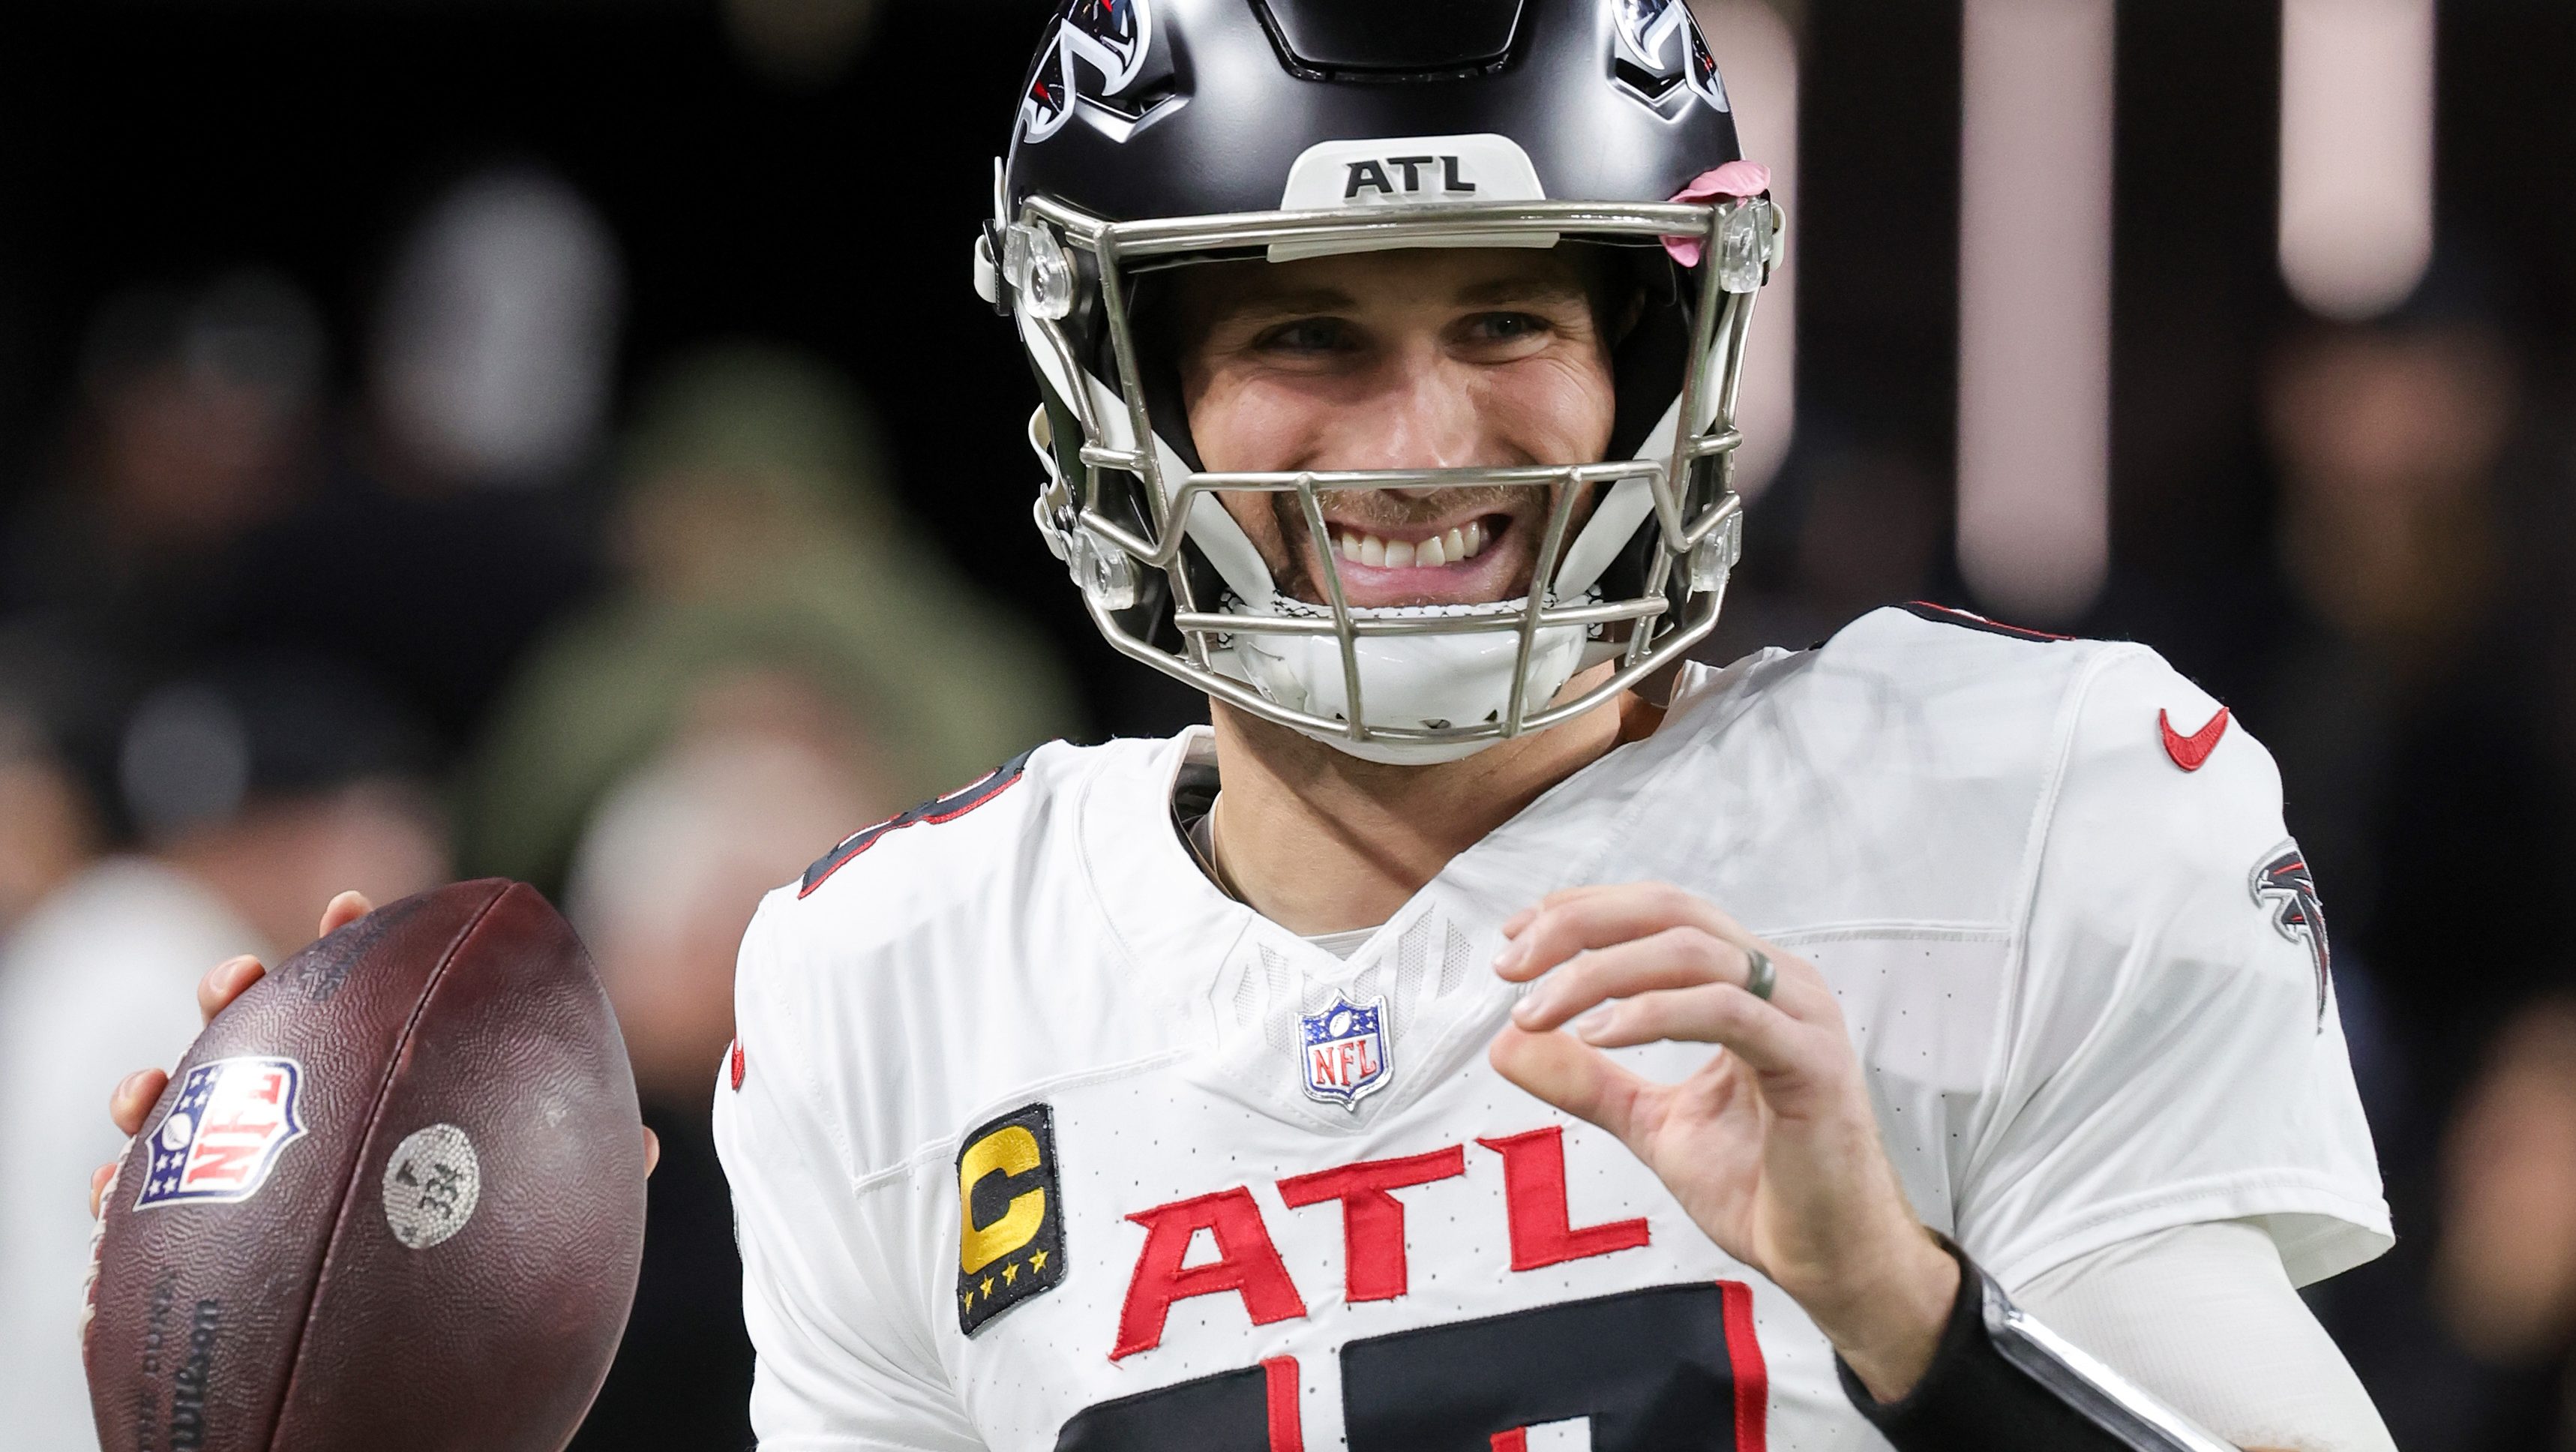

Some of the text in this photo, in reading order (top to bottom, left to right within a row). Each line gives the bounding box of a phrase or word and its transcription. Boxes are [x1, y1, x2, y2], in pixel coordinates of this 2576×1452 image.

[1345, 155, 1476, 198] ATL
[1314, 1040, 1377, 1086] NFL
[187, 1074, 283, 1184] NFL
[960, 1125, 1045, 1275] C
[1105, 1125, 1649, 1360] ATL
[169, 1299, 219, 1449] Wilson
